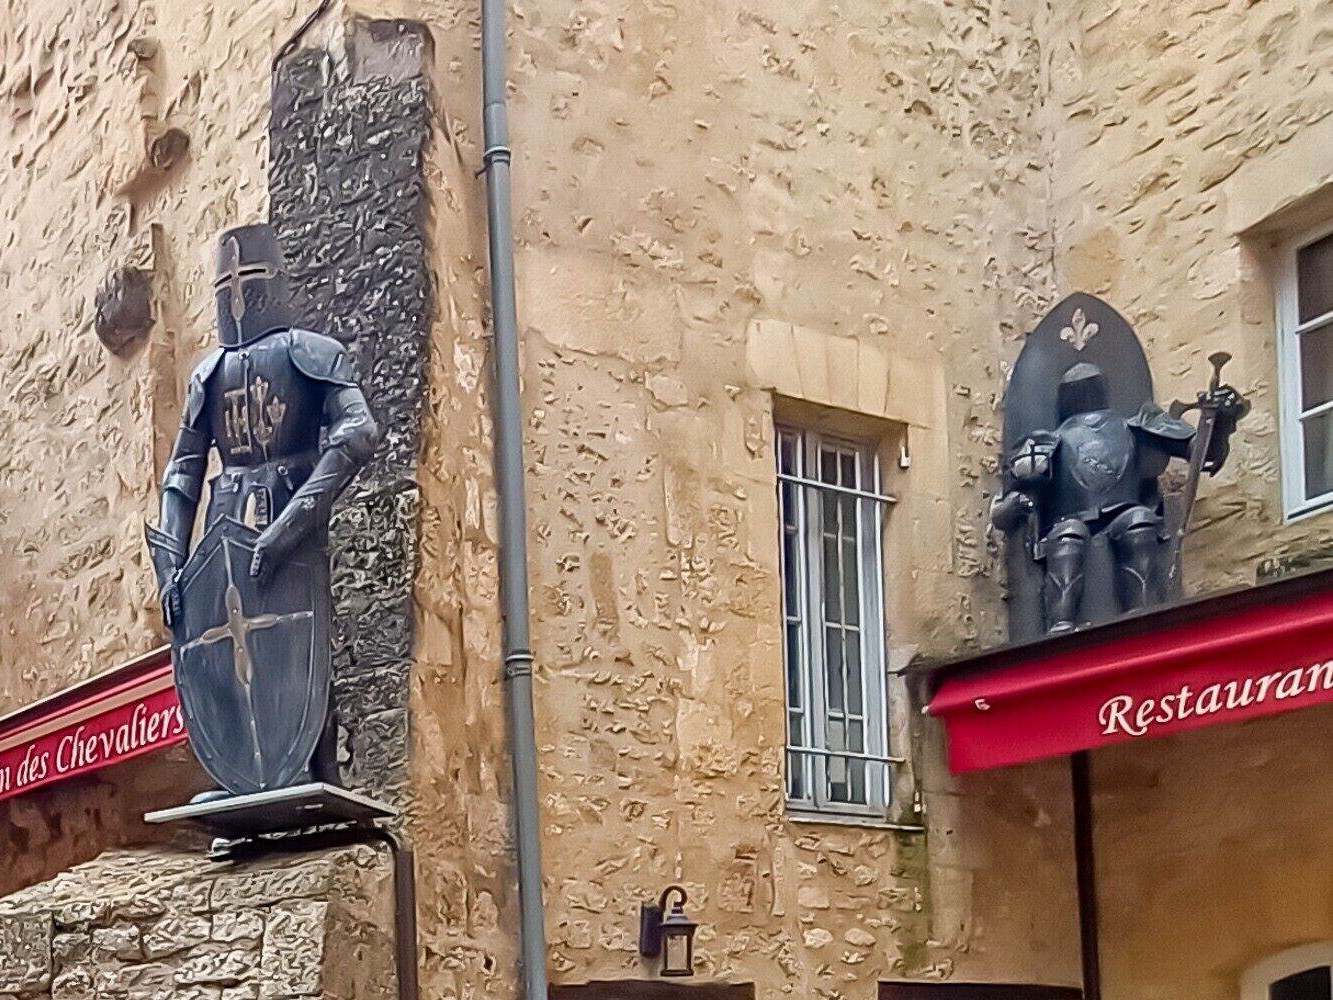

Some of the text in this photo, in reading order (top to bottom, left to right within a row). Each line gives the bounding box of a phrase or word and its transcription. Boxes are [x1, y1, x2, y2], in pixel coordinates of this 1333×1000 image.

[1098, 659, 1333, 736] Restauran
[16, 744, 49, 787] des
[56, 703, 184, 774] Chevaliers
